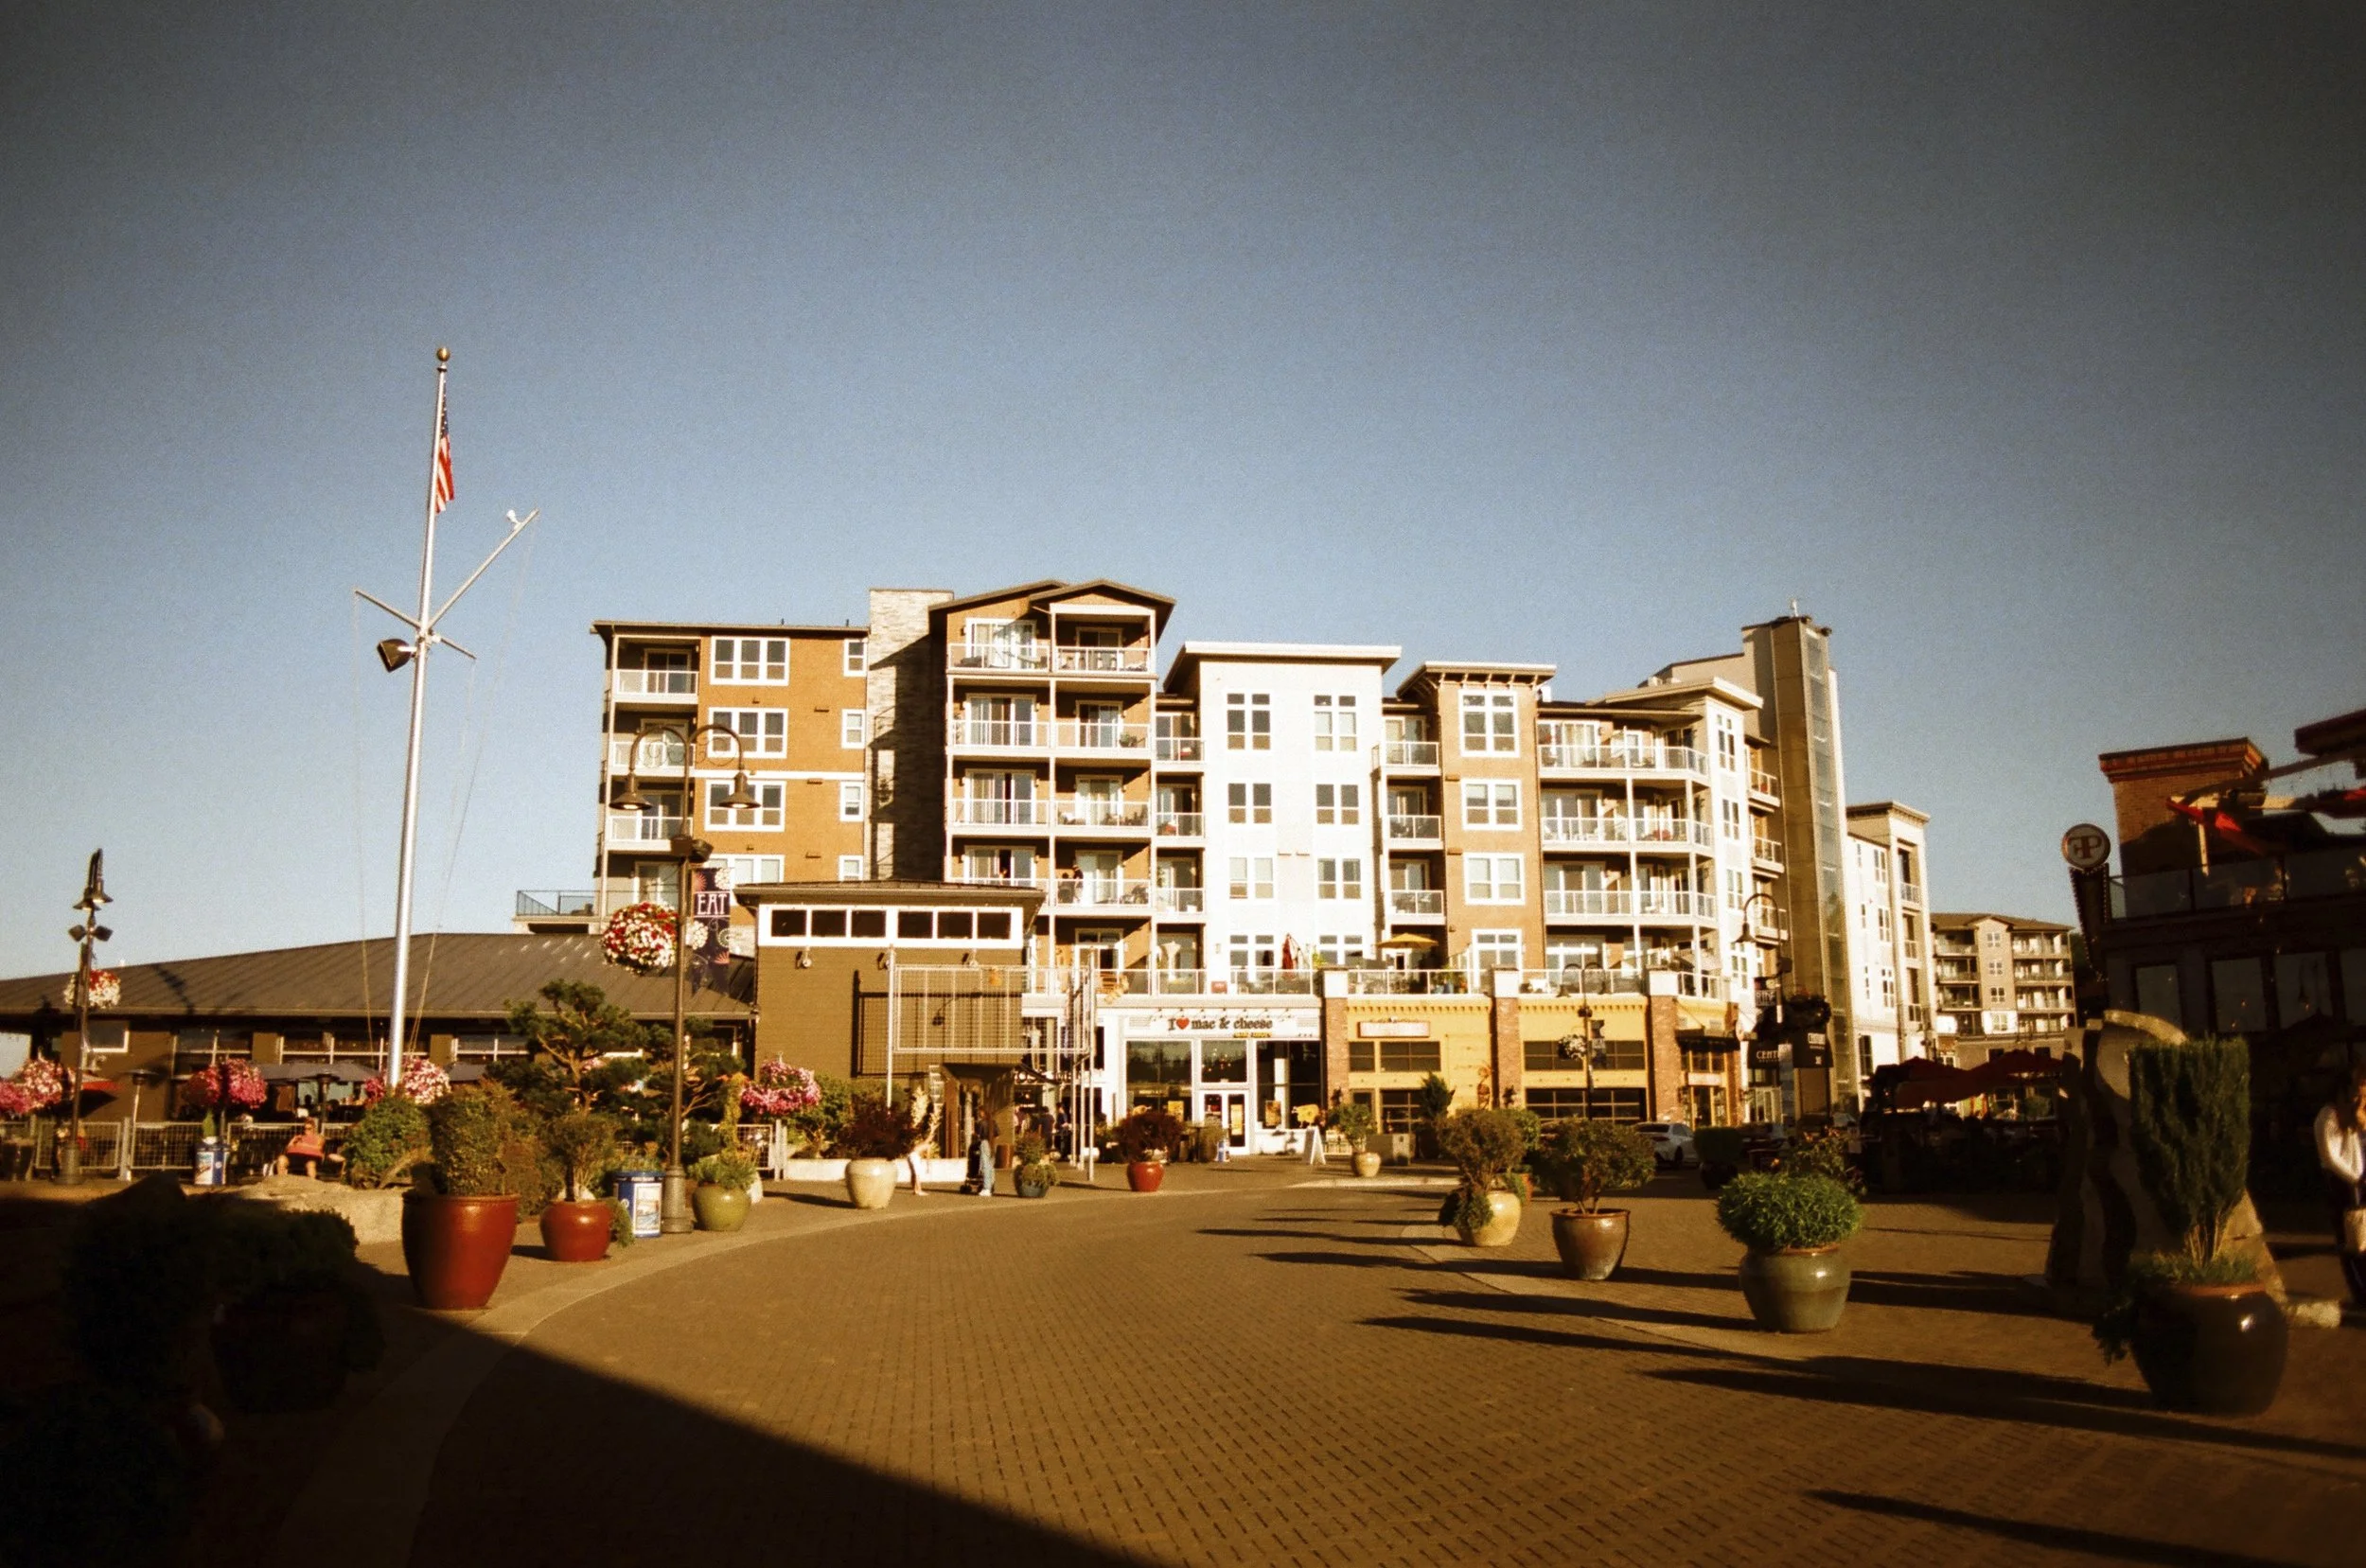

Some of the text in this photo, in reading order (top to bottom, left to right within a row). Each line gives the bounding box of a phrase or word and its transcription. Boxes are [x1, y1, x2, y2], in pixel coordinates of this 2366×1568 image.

[697, 893, 728, 915] EAT
[1191, 1018, 1215, 1030] mac
[1219, 1016, 1230, 1030] &
[1233, 1017, 1273, 1030] cheese
